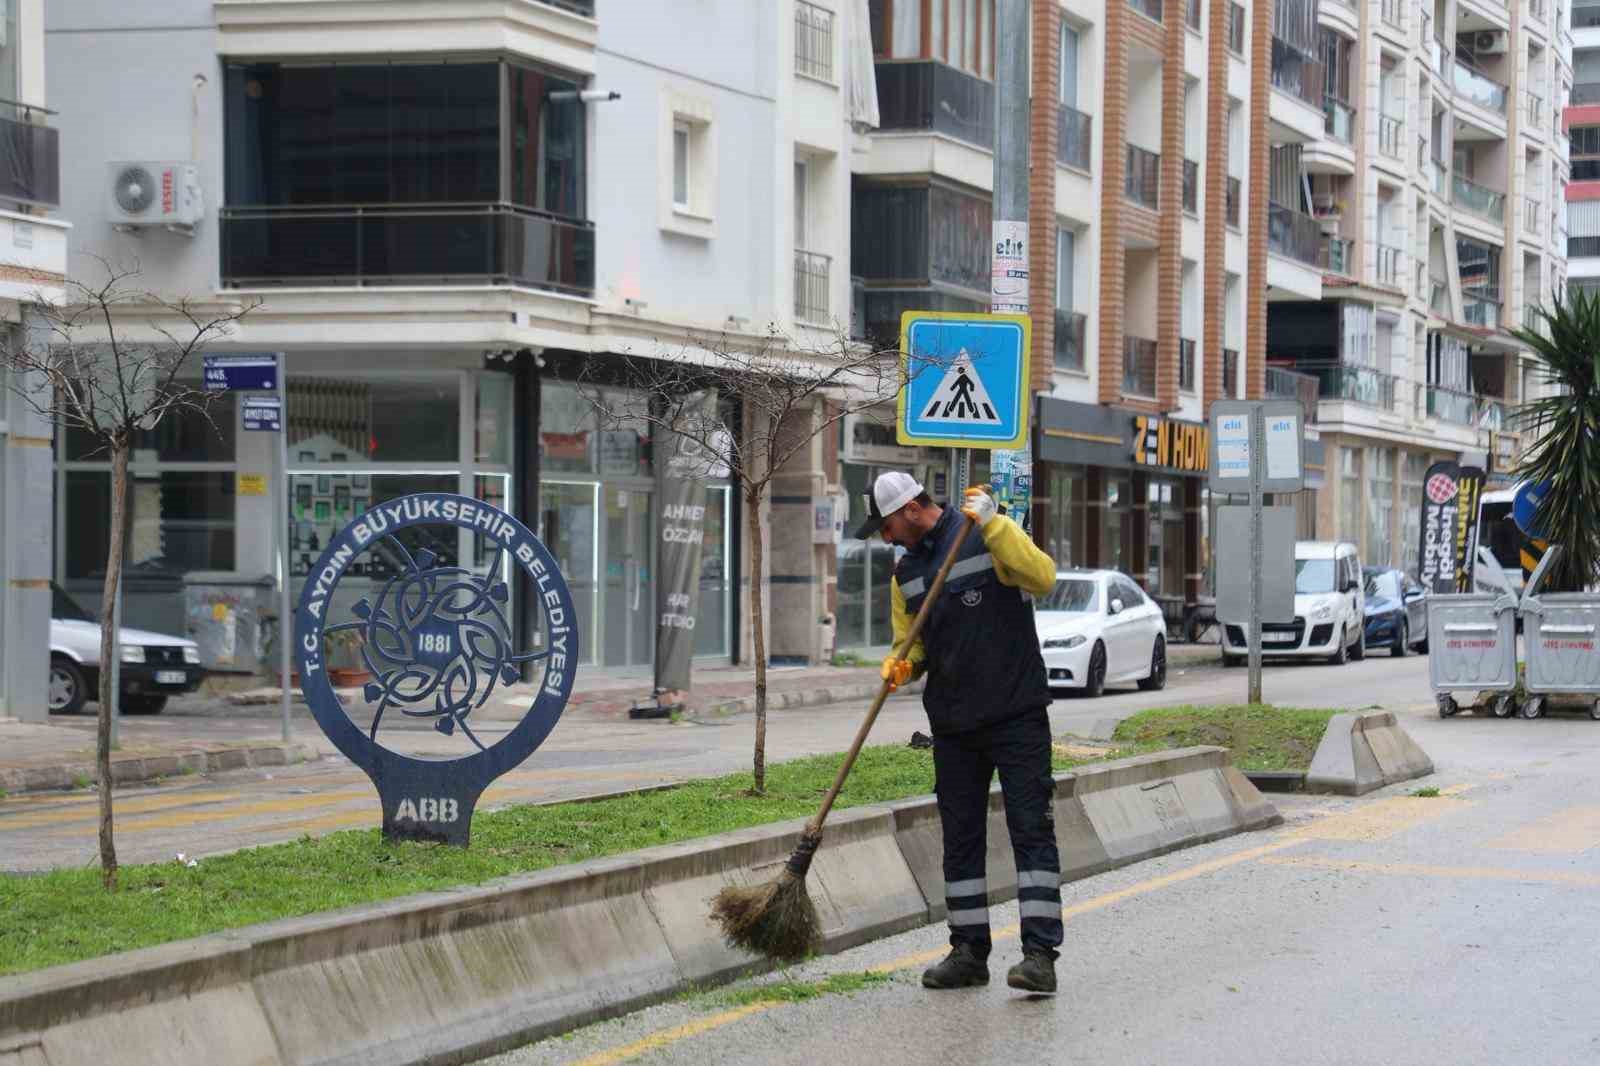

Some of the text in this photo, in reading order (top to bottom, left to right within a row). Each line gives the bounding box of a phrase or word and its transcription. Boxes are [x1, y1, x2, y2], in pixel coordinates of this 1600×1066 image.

[304, 497, 570, 697] T.C. AYDIN BÜYÜKŞEHİR BELEDİYESİ
[418, 633, 451, 654] 1881
[395, 798, 460, 823] ABB
